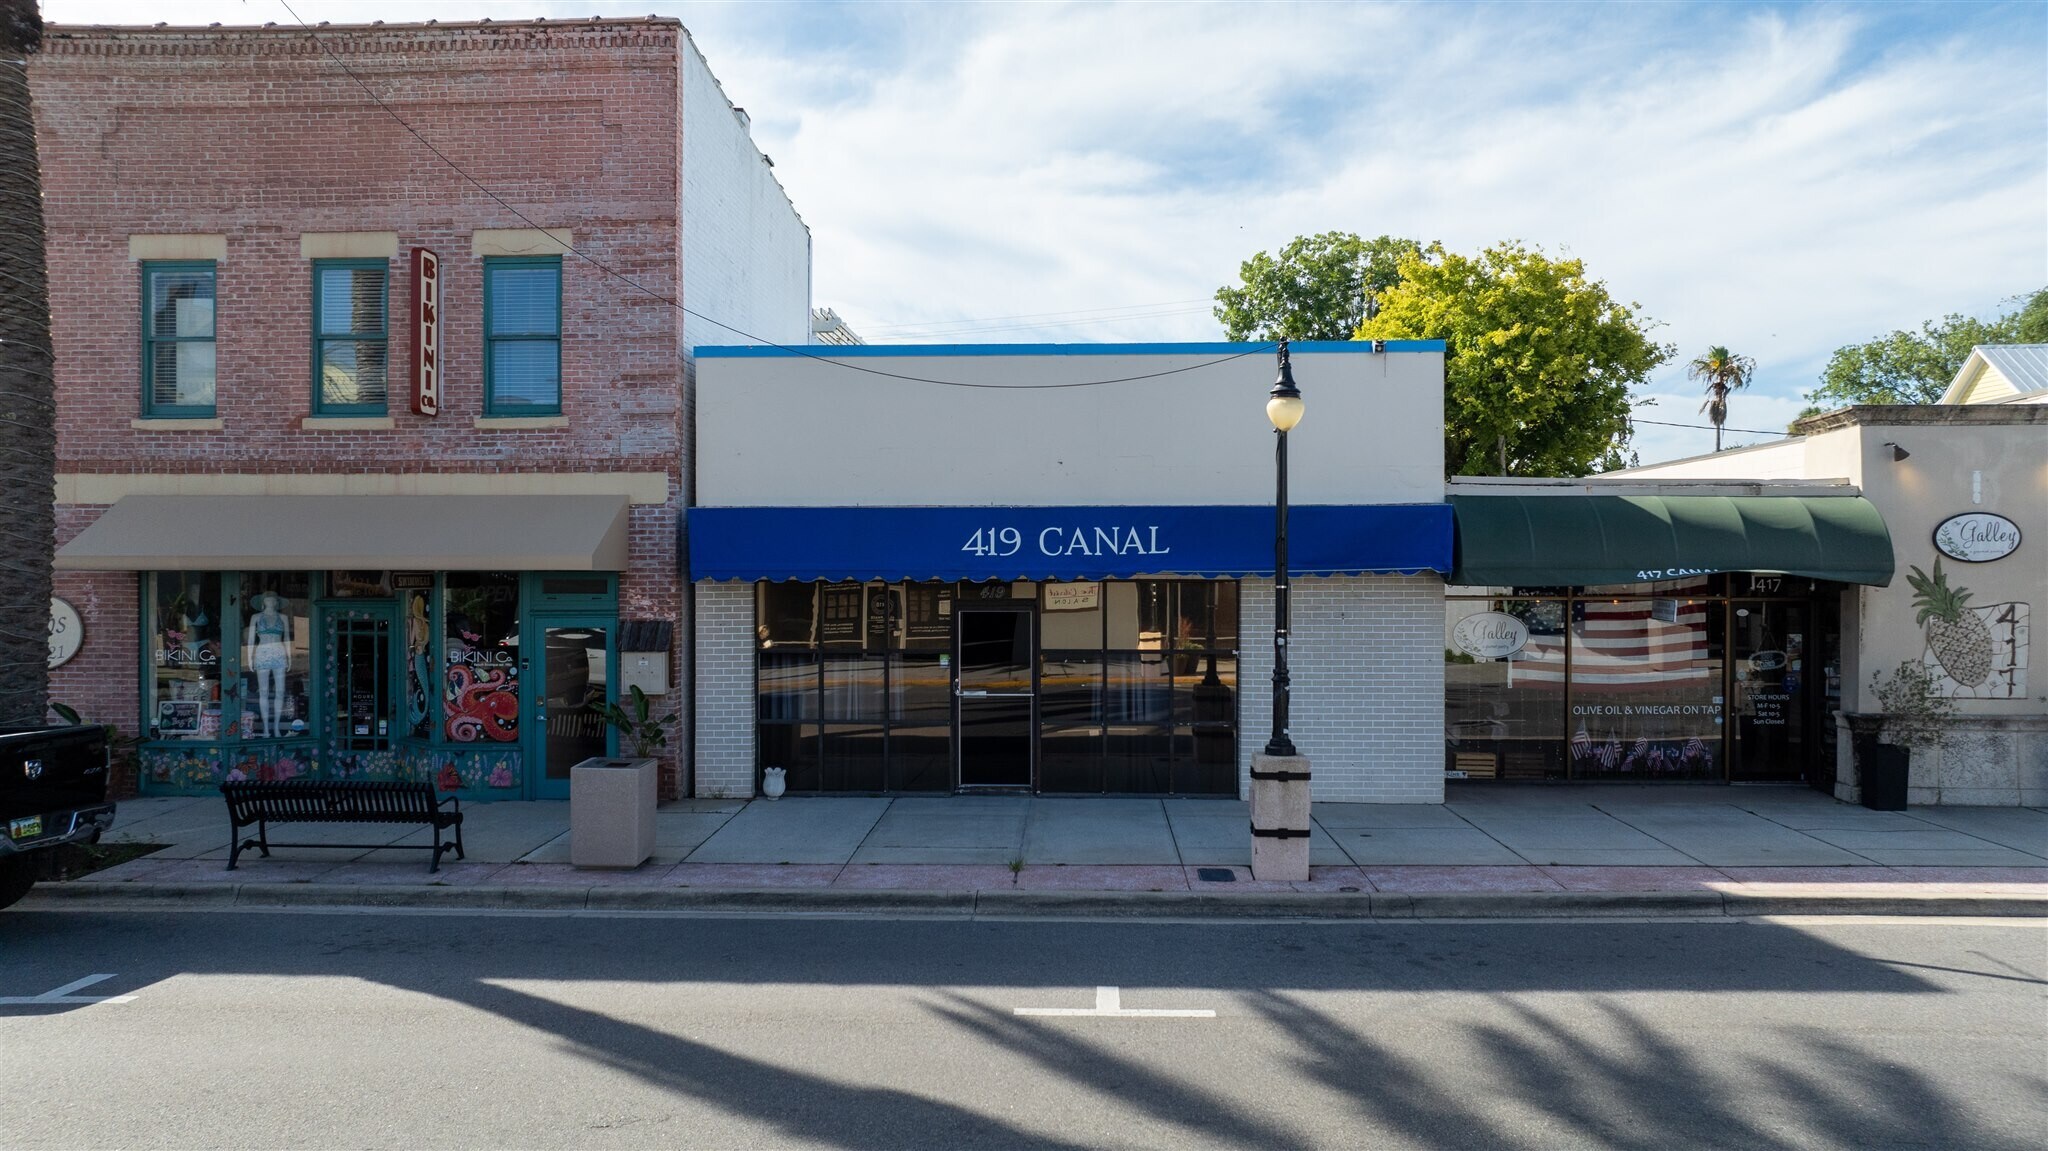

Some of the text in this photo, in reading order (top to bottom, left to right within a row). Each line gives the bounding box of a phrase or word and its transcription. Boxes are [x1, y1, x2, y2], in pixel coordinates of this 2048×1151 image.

[423, 257, 435, 390] BIKINI
[961, 526, 1170, 558] 419 CANAL
[1960, 519, 2016, 550] Galley
[1636, 569, 1662, 580] 417
[1756, 578, 1782, 593] 417
[1473, 619, 1517, 647] Galley
[155, 649, 196, 661] BIKINI
[450, 651, 492, 663] BIKINI
[1572, 705, 1722, 715] OLIVE OIL & VINEGAR ON TAP
